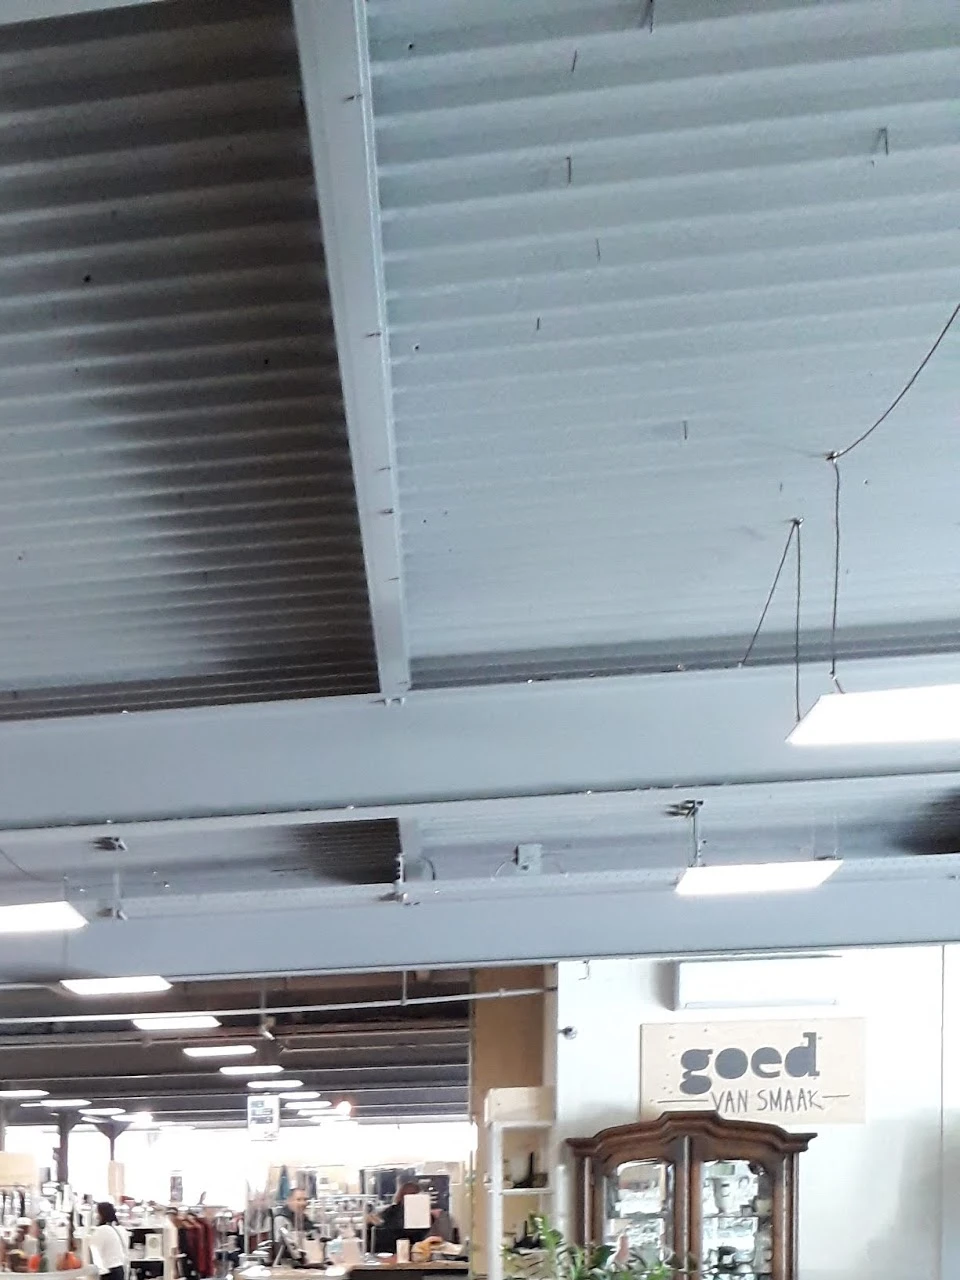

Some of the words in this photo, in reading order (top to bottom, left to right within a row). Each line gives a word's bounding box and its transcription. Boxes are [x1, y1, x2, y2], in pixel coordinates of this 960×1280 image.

[680, 1032, 820, 1095] goed
[710, 1089, 748, 1114] VAN
[756, 1087, 825, 1112] SMAAK
